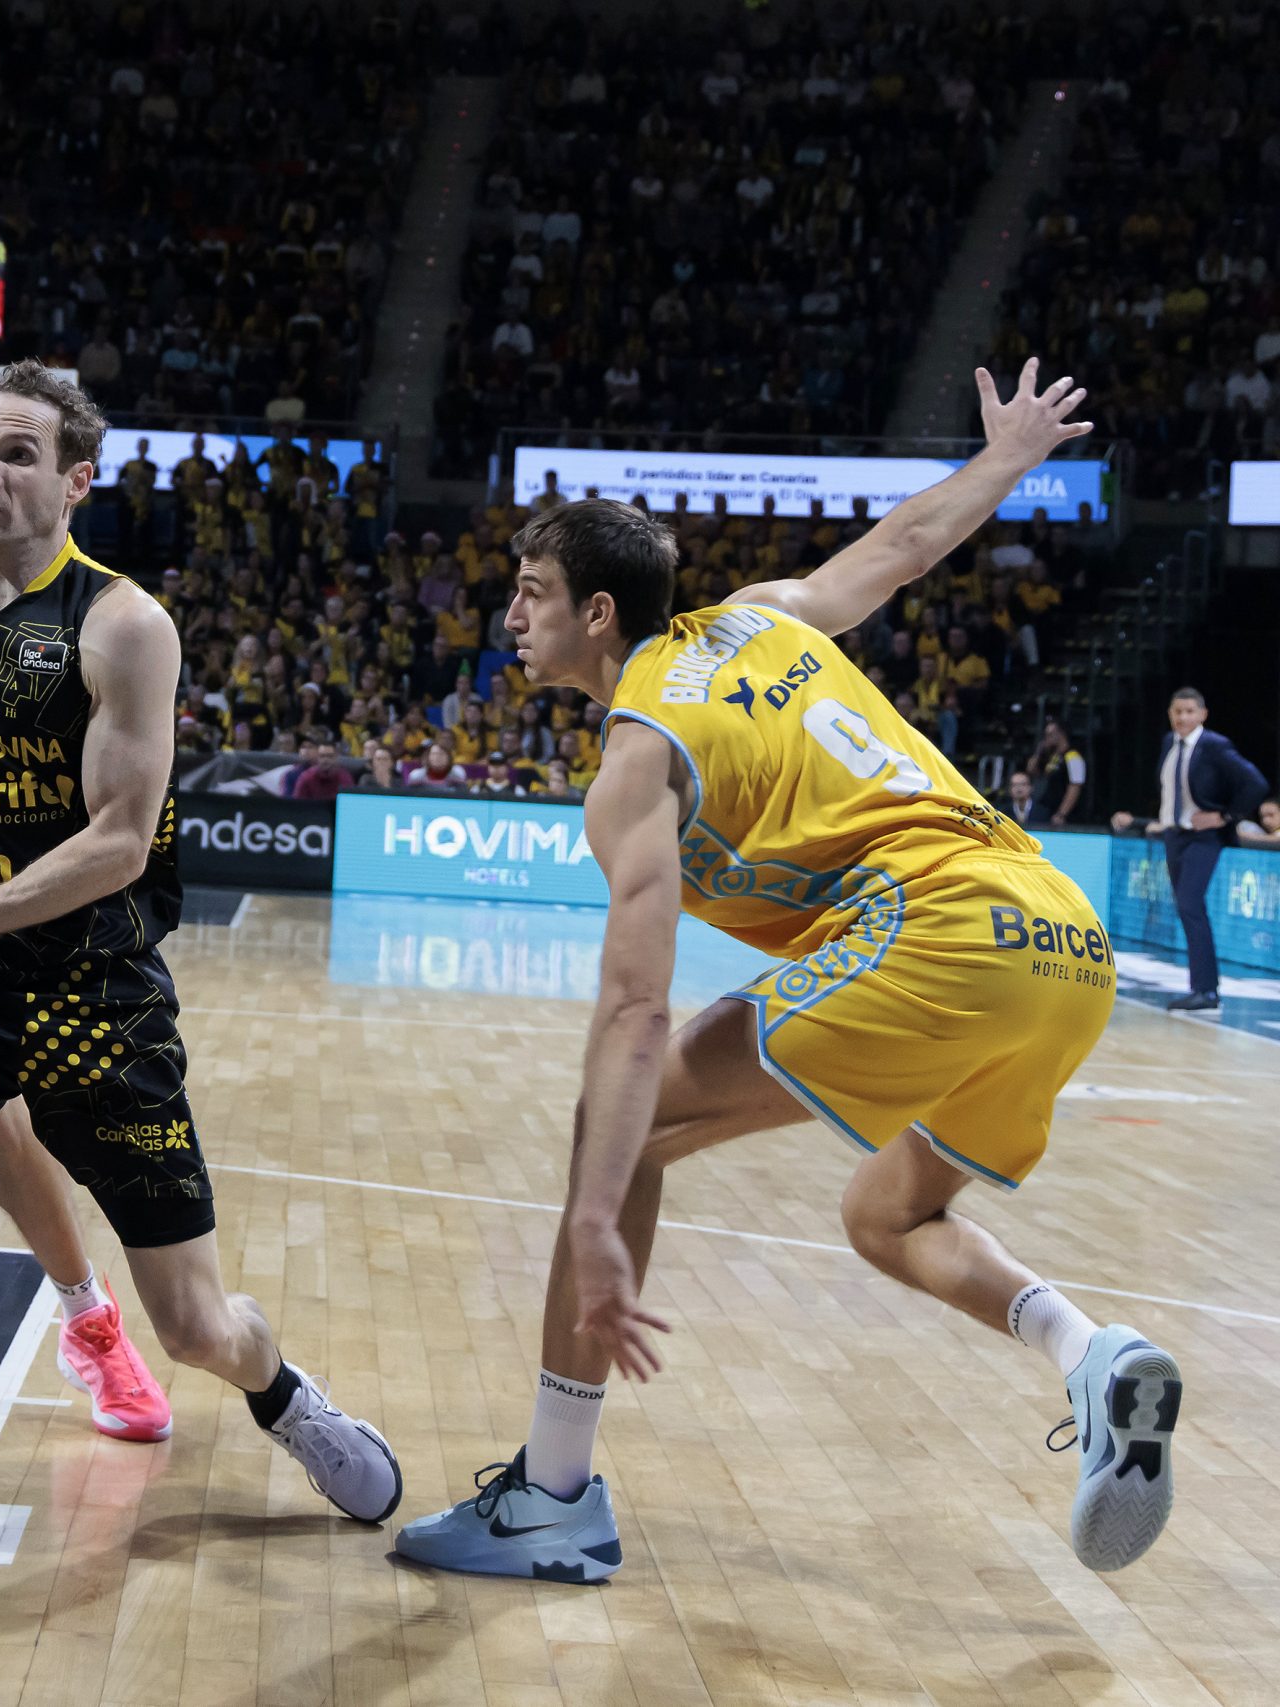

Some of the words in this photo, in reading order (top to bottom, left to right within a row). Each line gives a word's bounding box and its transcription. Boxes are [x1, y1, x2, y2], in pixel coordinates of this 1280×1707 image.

[624, 467, 636, 478] El
[1023, 474, 1068, 499] DÍA
[22, 659, 61, 670] endesa
[23, 648, 42, 660] liga
[661, 607, 776, 704] BRUSSINO
[180, 811, 331, 858] ndesa
[464, 867, 530, 887] HOTELS
[989, 905, 1117, 969] Barcel
[1031, 959, 1070, 980] HOTEL
[1075, 967, 1112, 990] GROUP
[539, 1373, 605, 1401] SPALDIN
